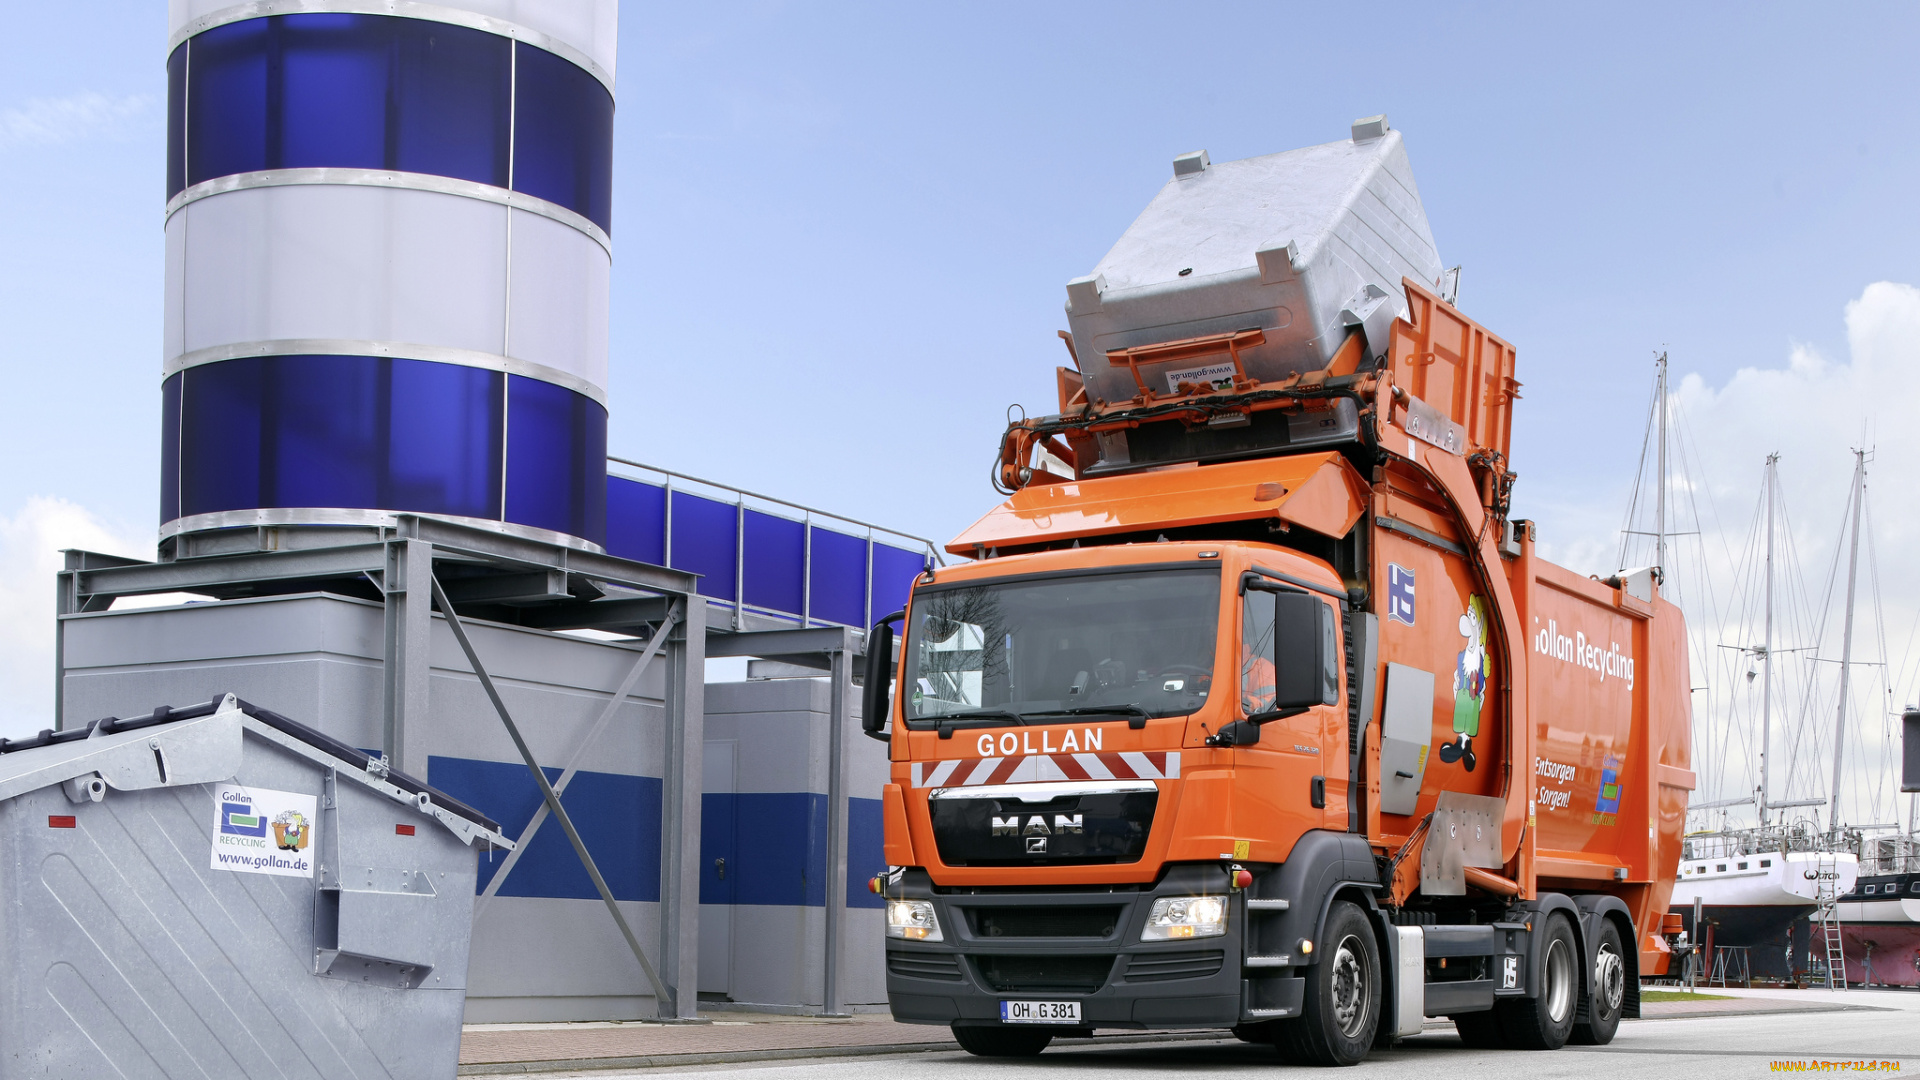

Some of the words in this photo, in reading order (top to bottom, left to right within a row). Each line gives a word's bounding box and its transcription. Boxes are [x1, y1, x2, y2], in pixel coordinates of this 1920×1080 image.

[1170, 365, 1232, 381] www.gollan.de
[1535, 615, 1574, 663] ollan
[1576, 630, 1634, 691] Recycling
[977, 728, 1103, 757] GOLLAN
[1535, 756, 1576, 785] Entsorgen
[222, 791, 252, 803] Gollan
[1537, 785, 1571, 811] Sorgen!
[991, 814, 1083, 837] MAN
[219, 835, 267, 849] RECYCLING
[218, 853, 309, 871] www.gollan.de
[1012, 1003, 1031, 1018] OH
[1039, 1003, 1048, 1018] G
[1050, 1003, 1076, 1019] 381
